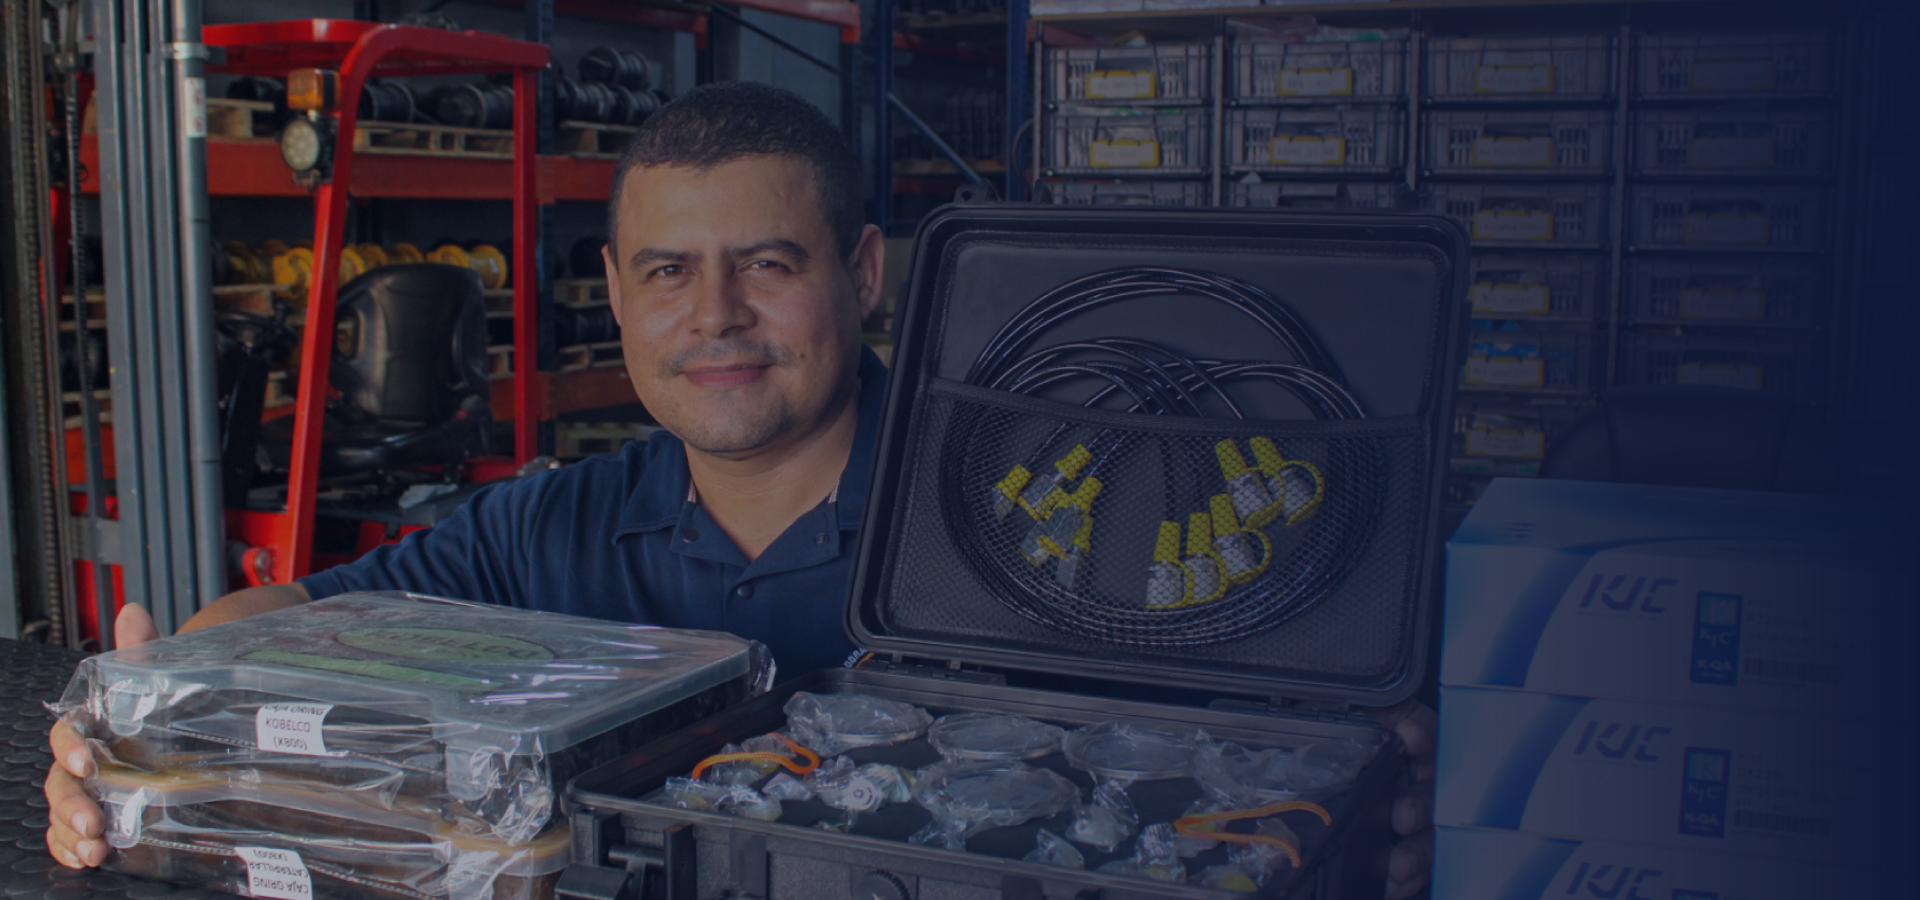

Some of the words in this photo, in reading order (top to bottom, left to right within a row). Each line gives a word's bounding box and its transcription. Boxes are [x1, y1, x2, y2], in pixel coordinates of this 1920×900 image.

[290, 705, 324, 716] ORING
[265, 716, 311, 733] KOBELCO
[273, 735, 308, 751] (X800)
[253, 876, 284, 891] ORING
[286, 880, 309, 894] CAJA
